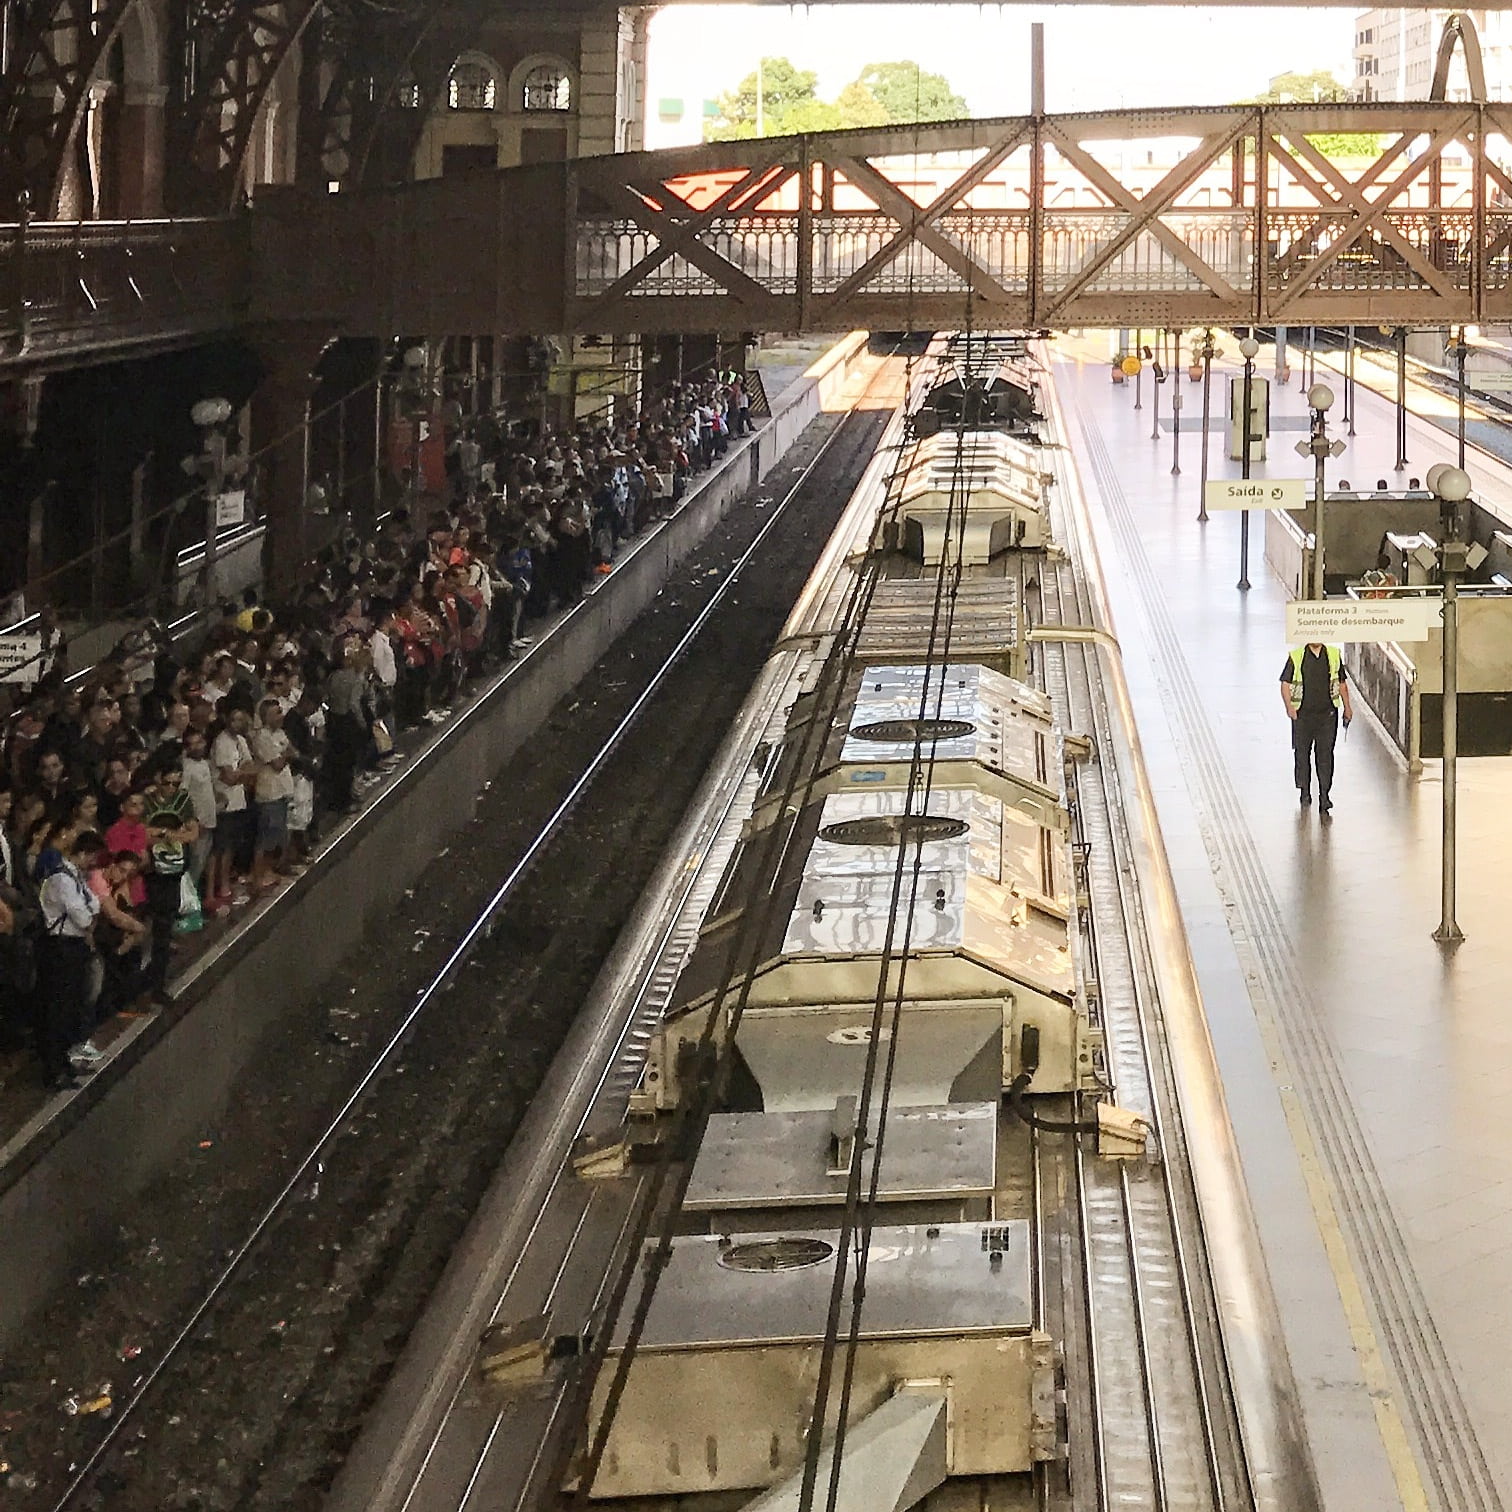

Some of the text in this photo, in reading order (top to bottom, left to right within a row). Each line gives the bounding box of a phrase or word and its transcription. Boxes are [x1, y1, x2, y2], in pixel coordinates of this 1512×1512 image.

[1227, 485, 1264, 497] Saída
[1297, 606, 1350, 615] Plataforma
[1351, 606, 1358, 615] 3
[1297, 616, 1405, 626] Somente desembarque
